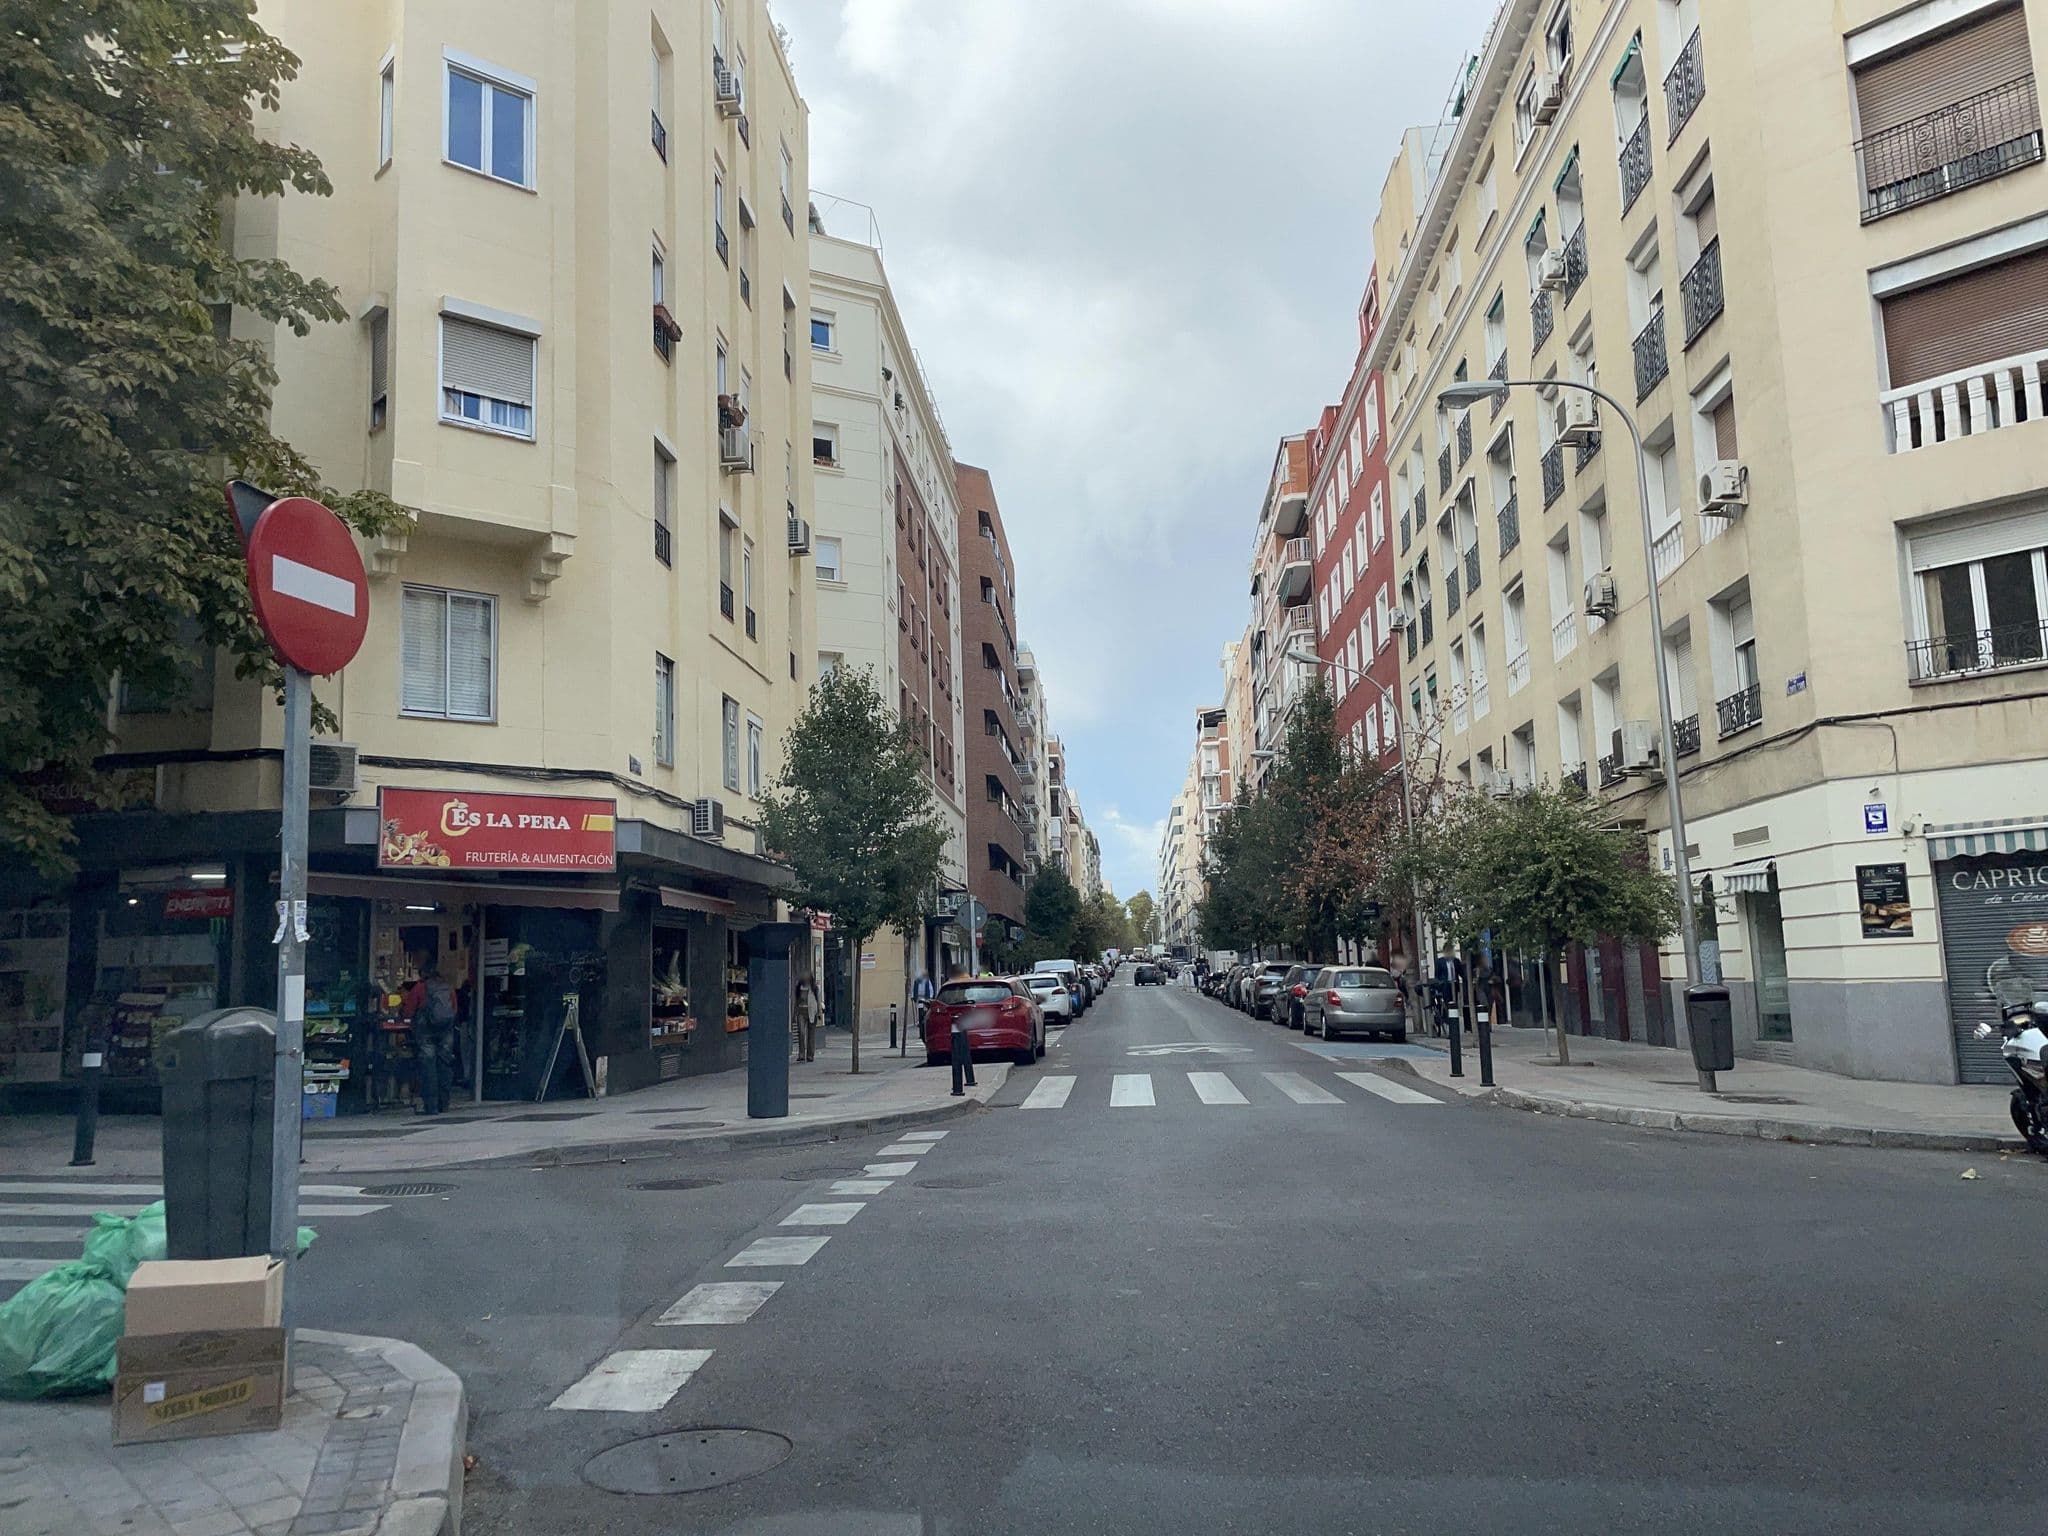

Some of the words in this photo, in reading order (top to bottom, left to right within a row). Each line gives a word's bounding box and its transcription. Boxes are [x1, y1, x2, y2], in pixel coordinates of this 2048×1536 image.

[486, 813, 513, 828] LA
[518, 814, 571, 830] PERA
[465, 850, 519, 864] FRUTERÍA
[520, 852, 531, 863] &
[532, 852, 614, 866] ALIMENTACIÓN
